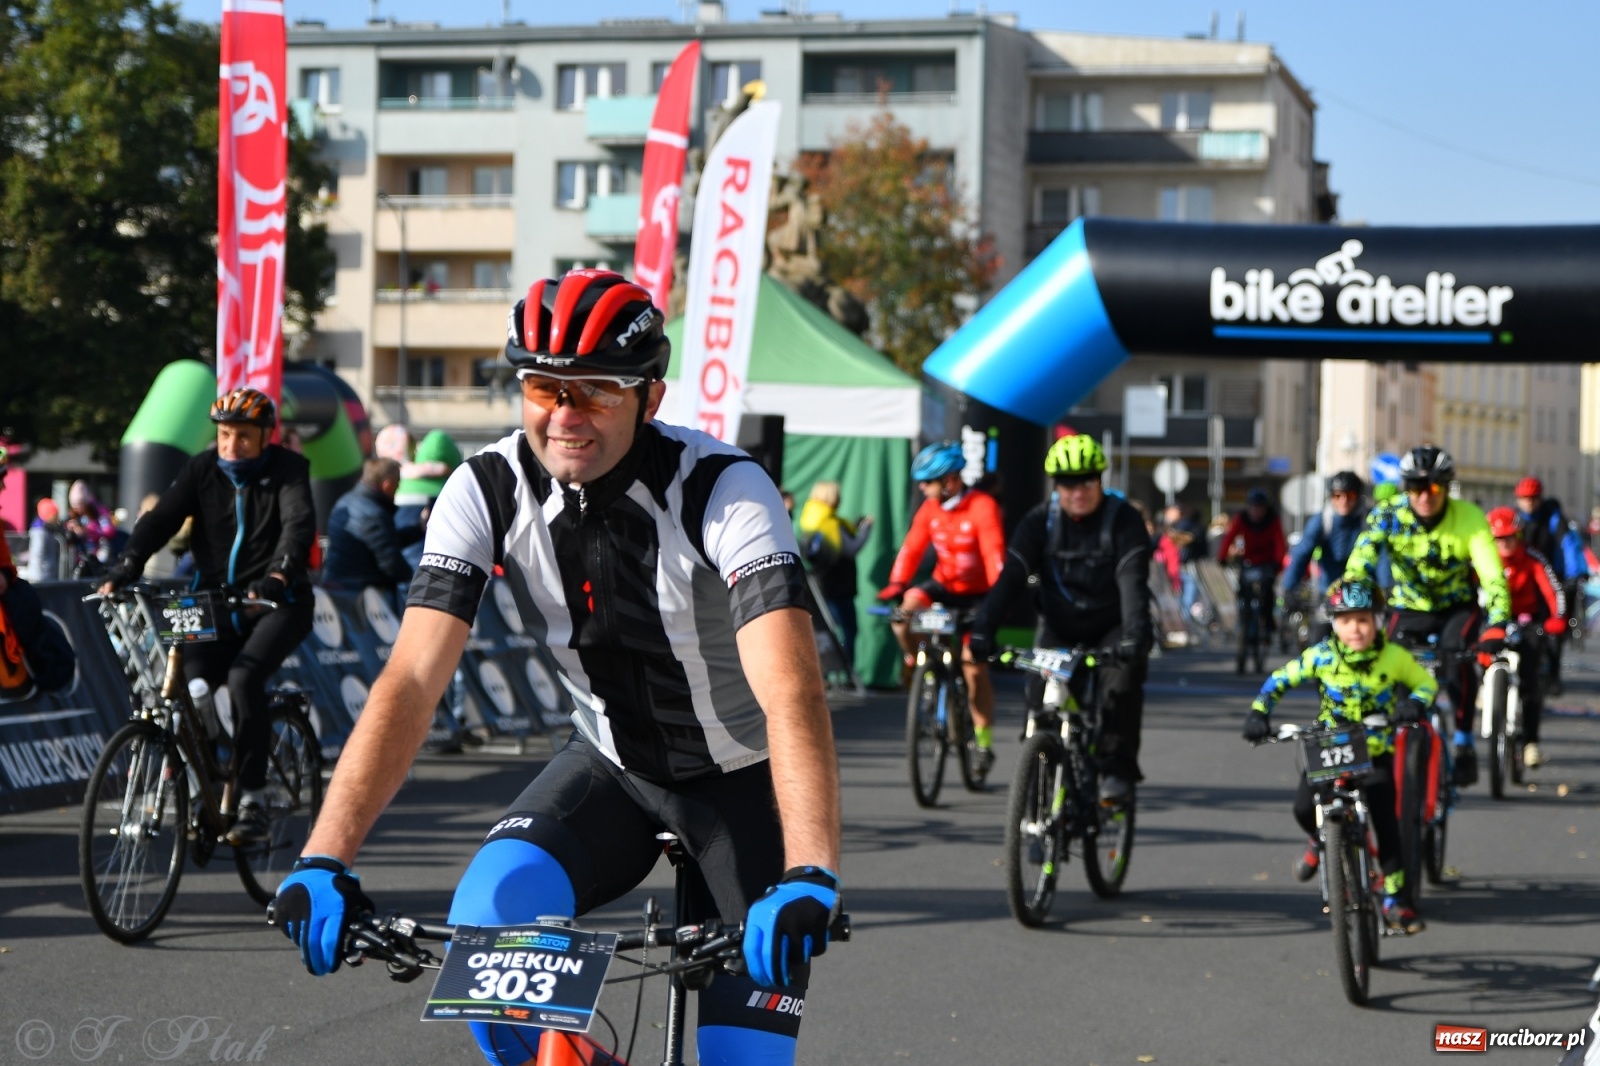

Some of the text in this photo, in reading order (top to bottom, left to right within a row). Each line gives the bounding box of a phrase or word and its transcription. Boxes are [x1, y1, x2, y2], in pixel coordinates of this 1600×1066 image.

[1210, 266, 1515, 327] bike atelier
[616, 306, 655, 347] MET
[536, 355, 574, 367] MET
[170, 615, 203, 633] 232
[1320, 745, 1355, 767] 175
[467, 952, 583, 975] OPIEKUN
[468, 969, 557, 1003] 303
